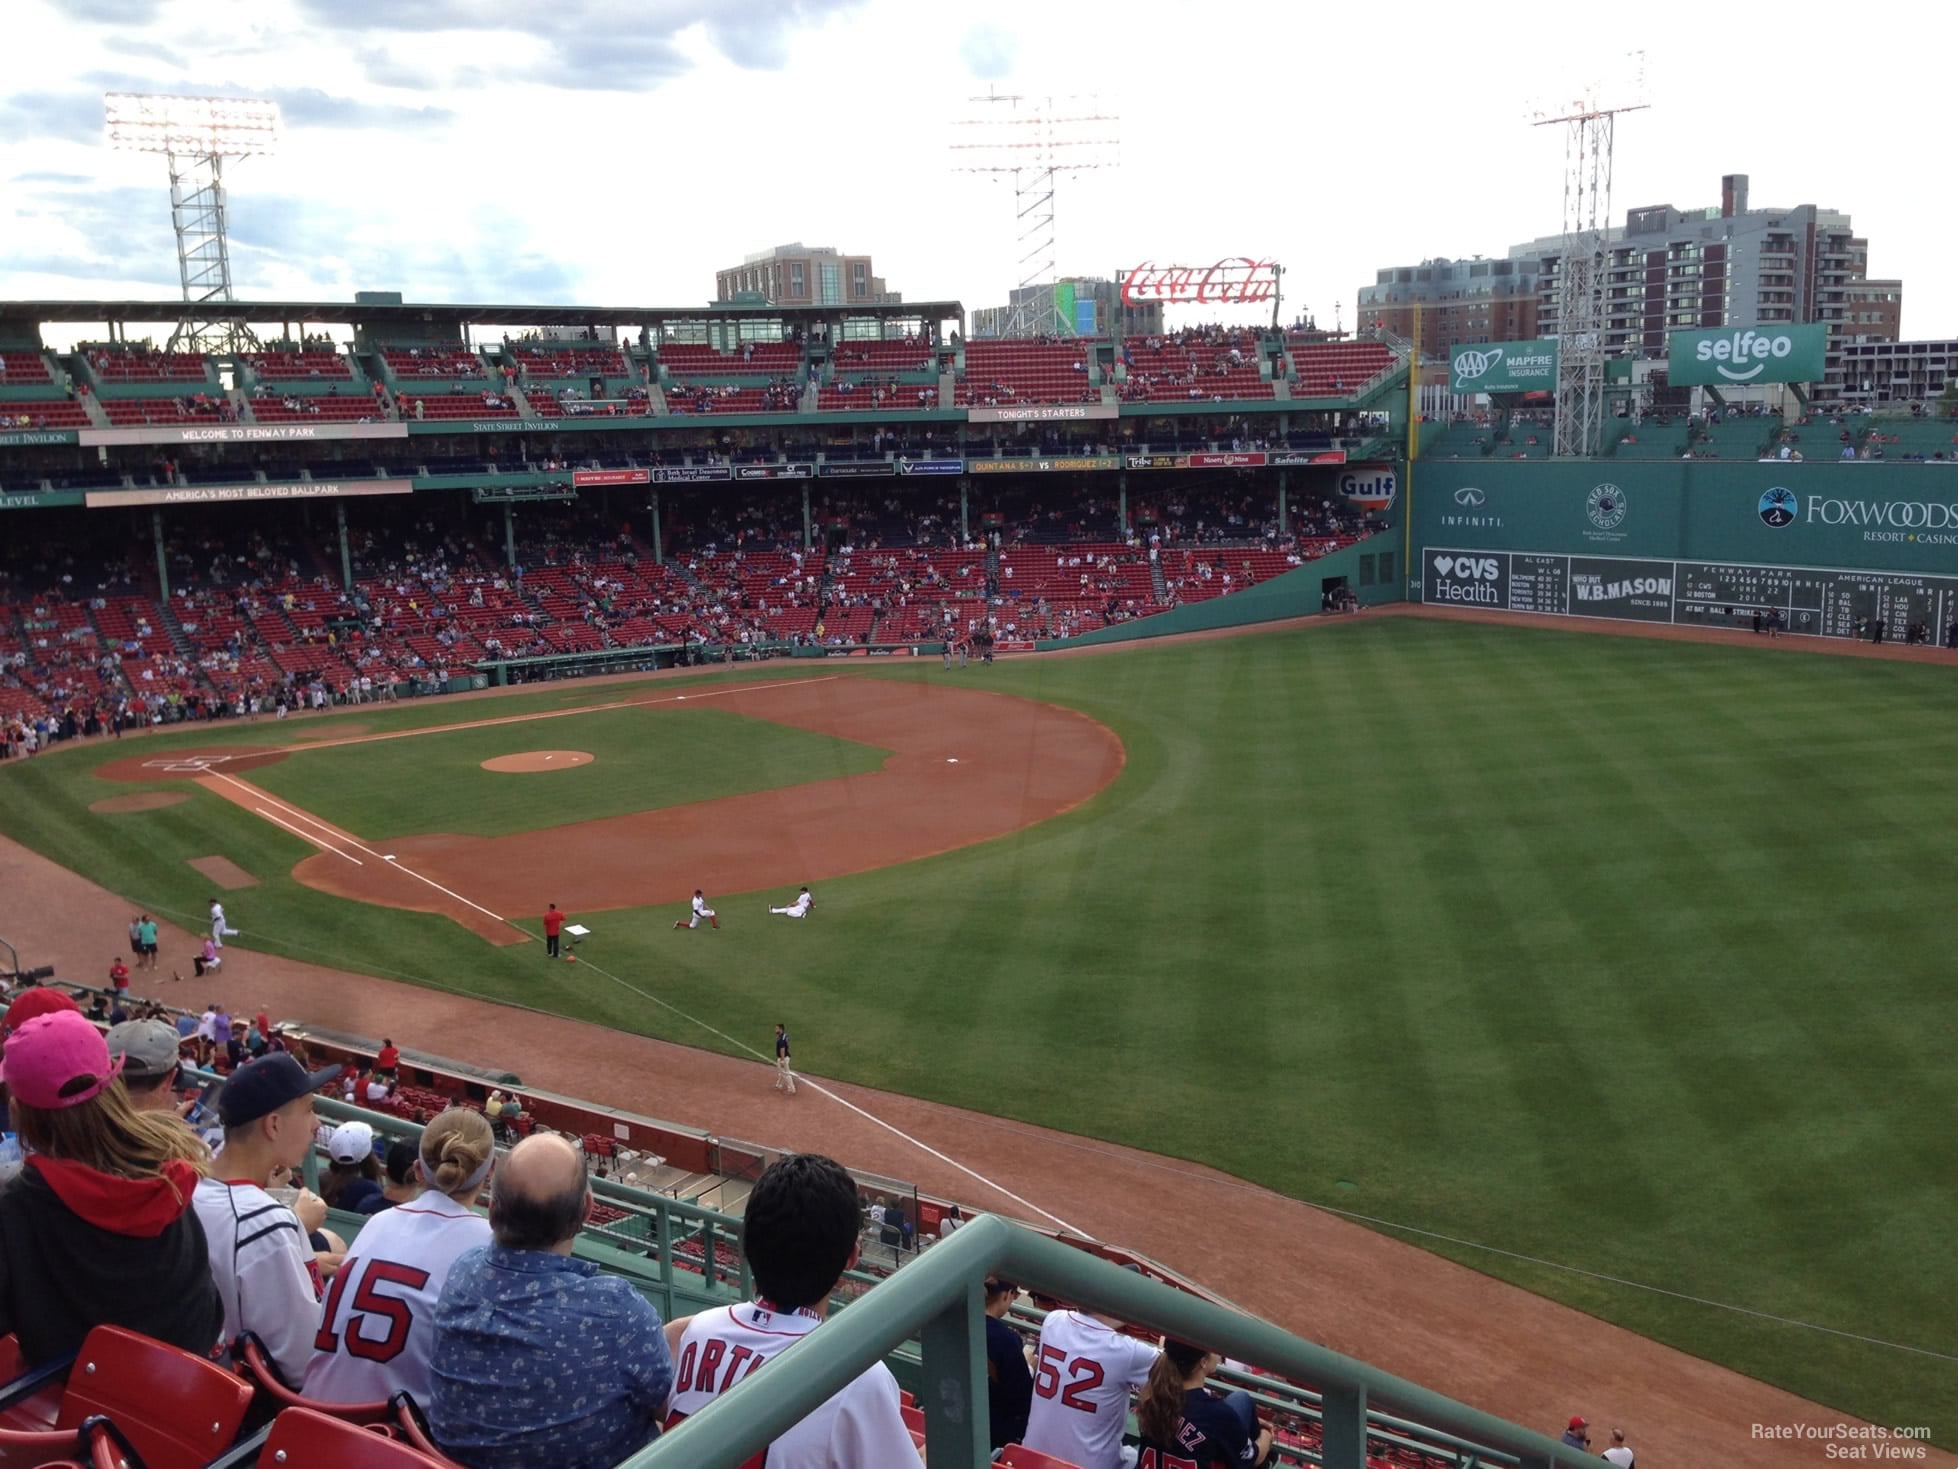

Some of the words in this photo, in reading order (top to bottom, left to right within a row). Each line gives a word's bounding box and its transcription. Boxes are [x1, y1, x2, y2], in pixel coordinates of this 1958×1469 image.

[1506, 355, 1552, 366] MAPFRE
[1509, 368, 1549, 377] INSURANCE
[998, 410, 1039, 419] TONIGHT'S
[1041, 408, 1086, 418] STARTERS
[473, 422, 495, 432] STATE
[524, 421, 559, 431] PAVILION
[23, 433, 67, 444] PAVILION
[182, 429, 228, 440] WELCOME
[232, 429, 243, 439] TO
[247, 428, 286, 439] FENWAY
[289, 427, 315, 438] PARK
[1128, 456, 1151, 468] Tribe
[1203, 456, 1223, 464] Ninety
[1274, 455, 1309, 464] Safelite
[975, 462, 1016, 471] QUINTANA
[1039, 461, 1049, 470] VS
[1055, 460, 1097, 469] RODRIGUEZ
[1341, 474, 1393, 496] Gulf
[165, 489, 216, 500] AMERICA'S
[219, 488, 244, 498] MOST
[247, 486, 289, 497] BELOVED
[291, 485, 339, 496] BALLPARK
[1589, 487, 1602, 504] RED
[1604, 485, 1620, 498] SOX
[0, 495, 39, 506] LEVEL
[1441, 515, 1501, 527] INFINITI
[1863, 531, 1906, 542] RESORT
[1454, 556, 1499, 580] CVS
[1703, 566, 1751, 575] FENWAY
[1760, 570, 1792, 578] PARK
[1838, 574, 1883, 583] AMERICAN
[1888, 578, 1923, 586] LEAGUE
[1435, 578, 1499, 604] Health
[1698, 582, 1712, 590] CWS
[1693, 591, 1716, 599] BOSTON
[1837, 613, 1851, 621] CLE
[1892, 625, 1906, 633] COL
[314, 1257, 431, 1364] 15
[1035, 1344, 1104, 1414] 52
